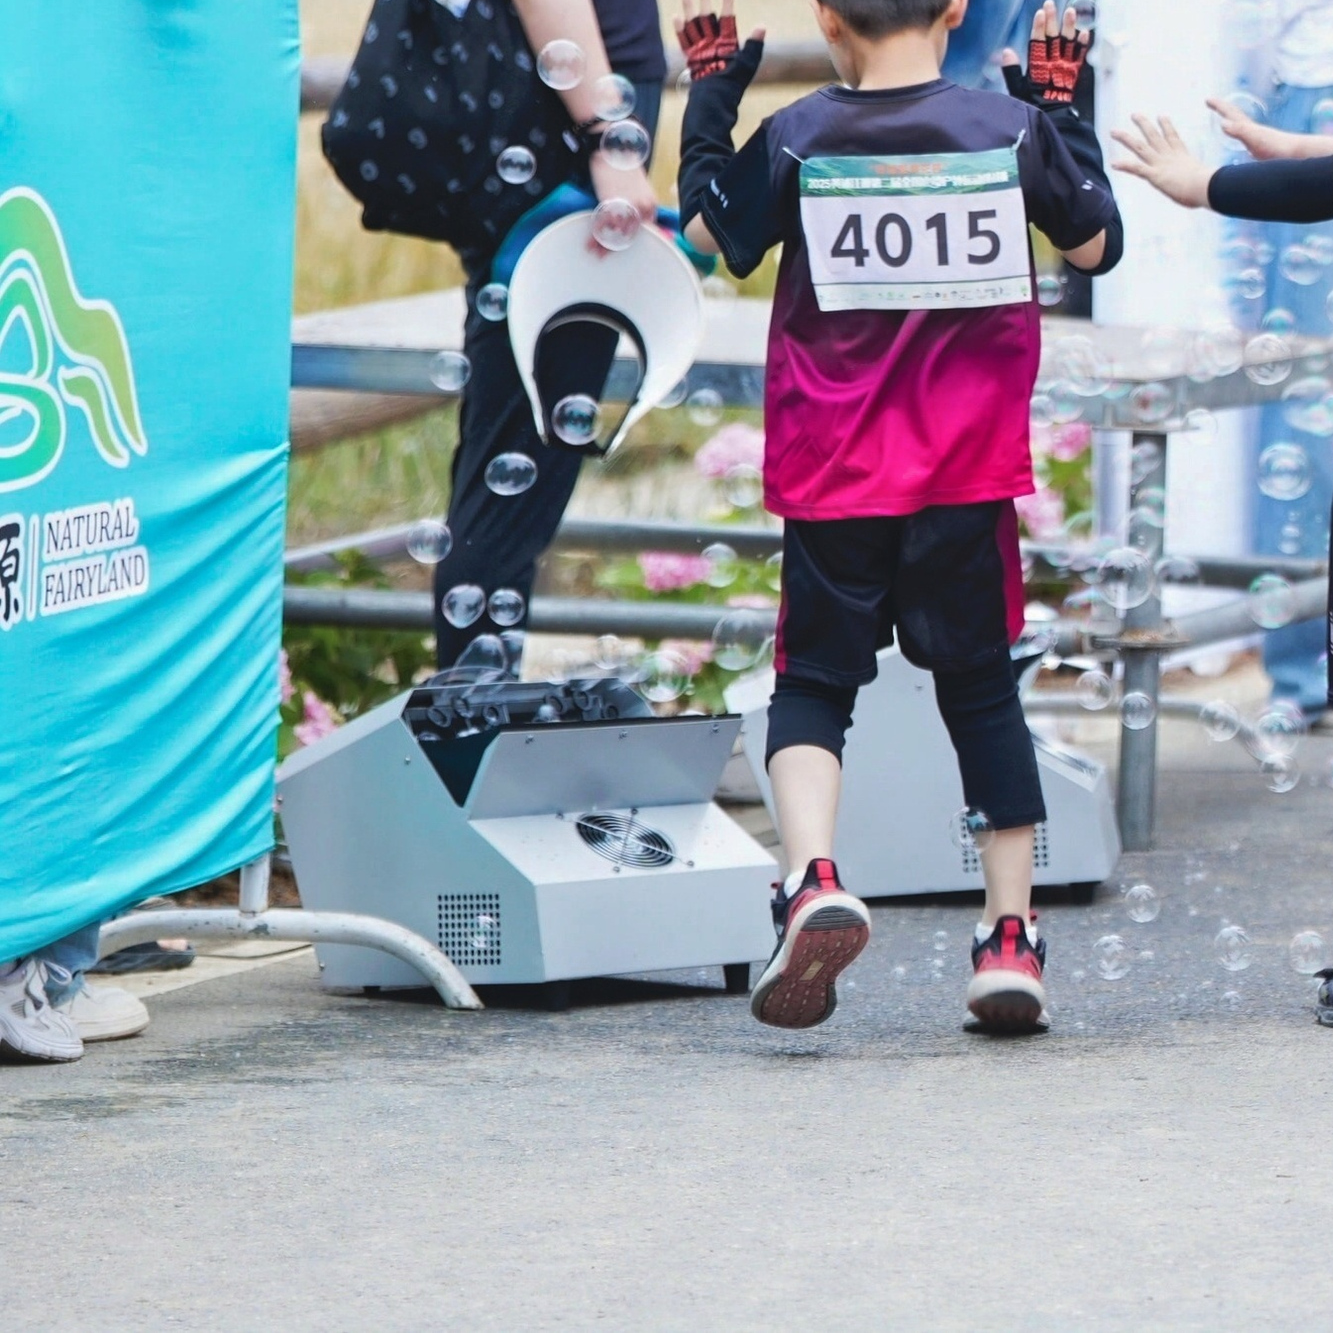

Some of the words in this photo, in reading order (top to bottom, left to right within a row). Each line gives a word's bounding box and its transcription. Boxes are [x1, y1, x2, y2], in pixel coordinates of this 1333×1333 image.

[830, 209, 1000, 268] 4015
[46, 506, 136, 555] NATURAL
[44, 554, 146, 608] FAIRYLAND
